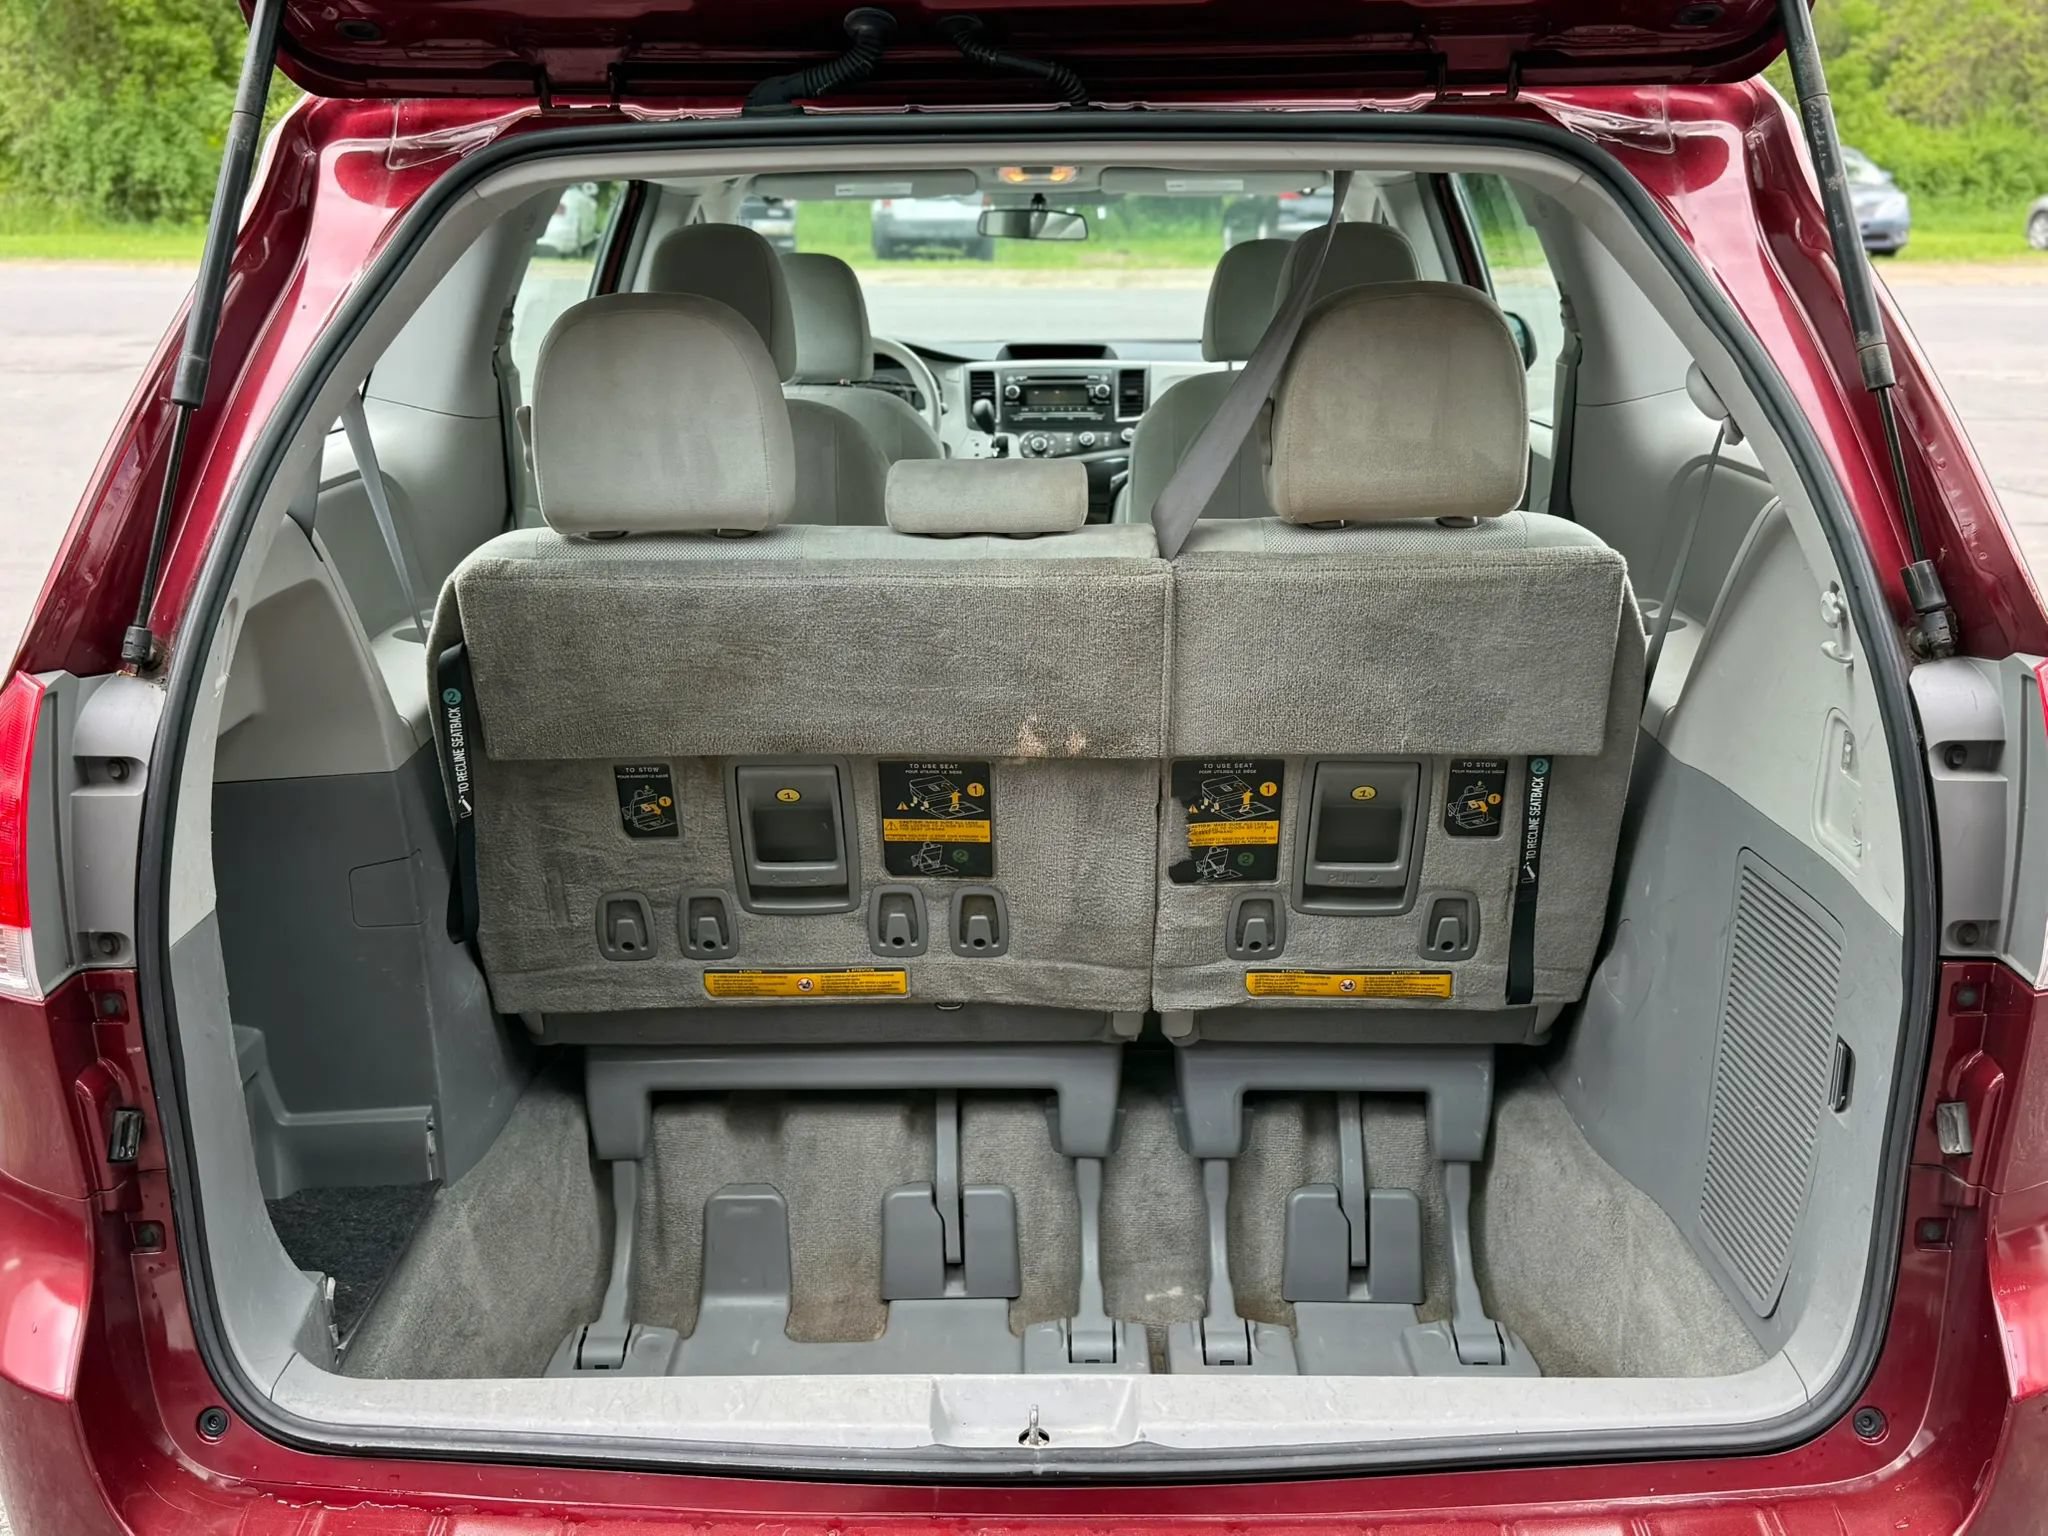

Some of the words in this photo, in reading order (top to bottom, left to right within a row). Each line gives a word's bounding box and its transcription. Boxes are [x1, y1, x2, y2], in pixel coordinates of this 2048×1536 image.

[448, 706, 464, 748] SEATBACK
[452, 748, 468, 783] RECLINE
[458, 782, 470, 795] TO
[1529, 776, 1544, 816] SEATBACK
[1527, 817, 1540, 850] RECLINE
[1525, 850, 1537, 861] TO
